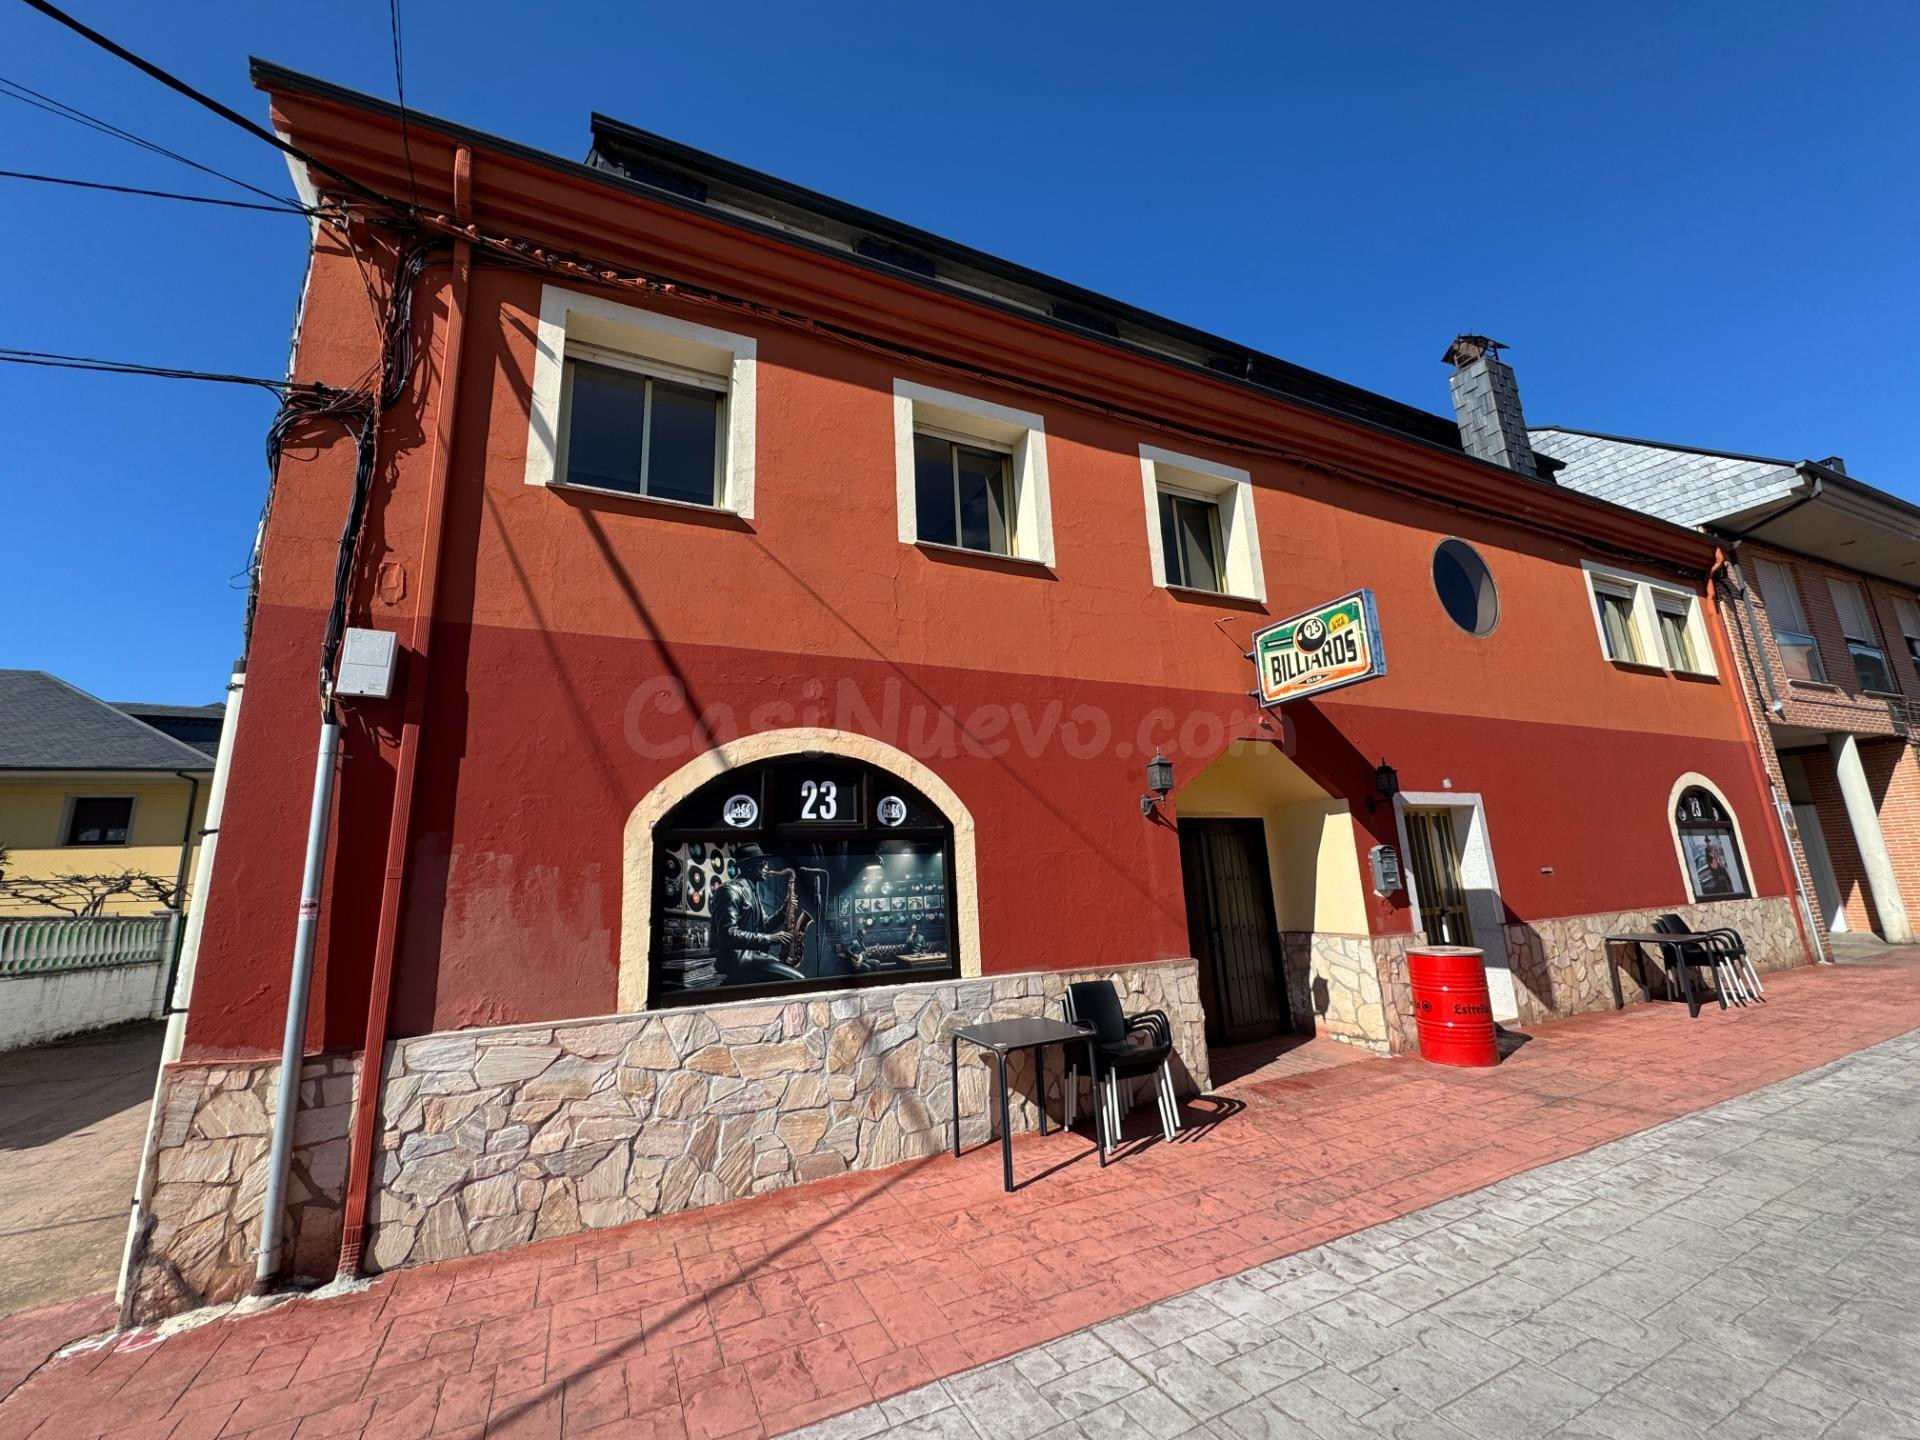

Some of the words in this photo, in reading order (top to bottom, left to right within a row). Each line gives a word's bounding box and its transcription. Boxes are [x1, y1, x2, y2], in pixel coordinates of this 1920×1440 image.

[1306, 621, 1321, 637] 23
[1271, 629, 1358, 686] BILLIARDS
[801, 780, 837, 820] 23
